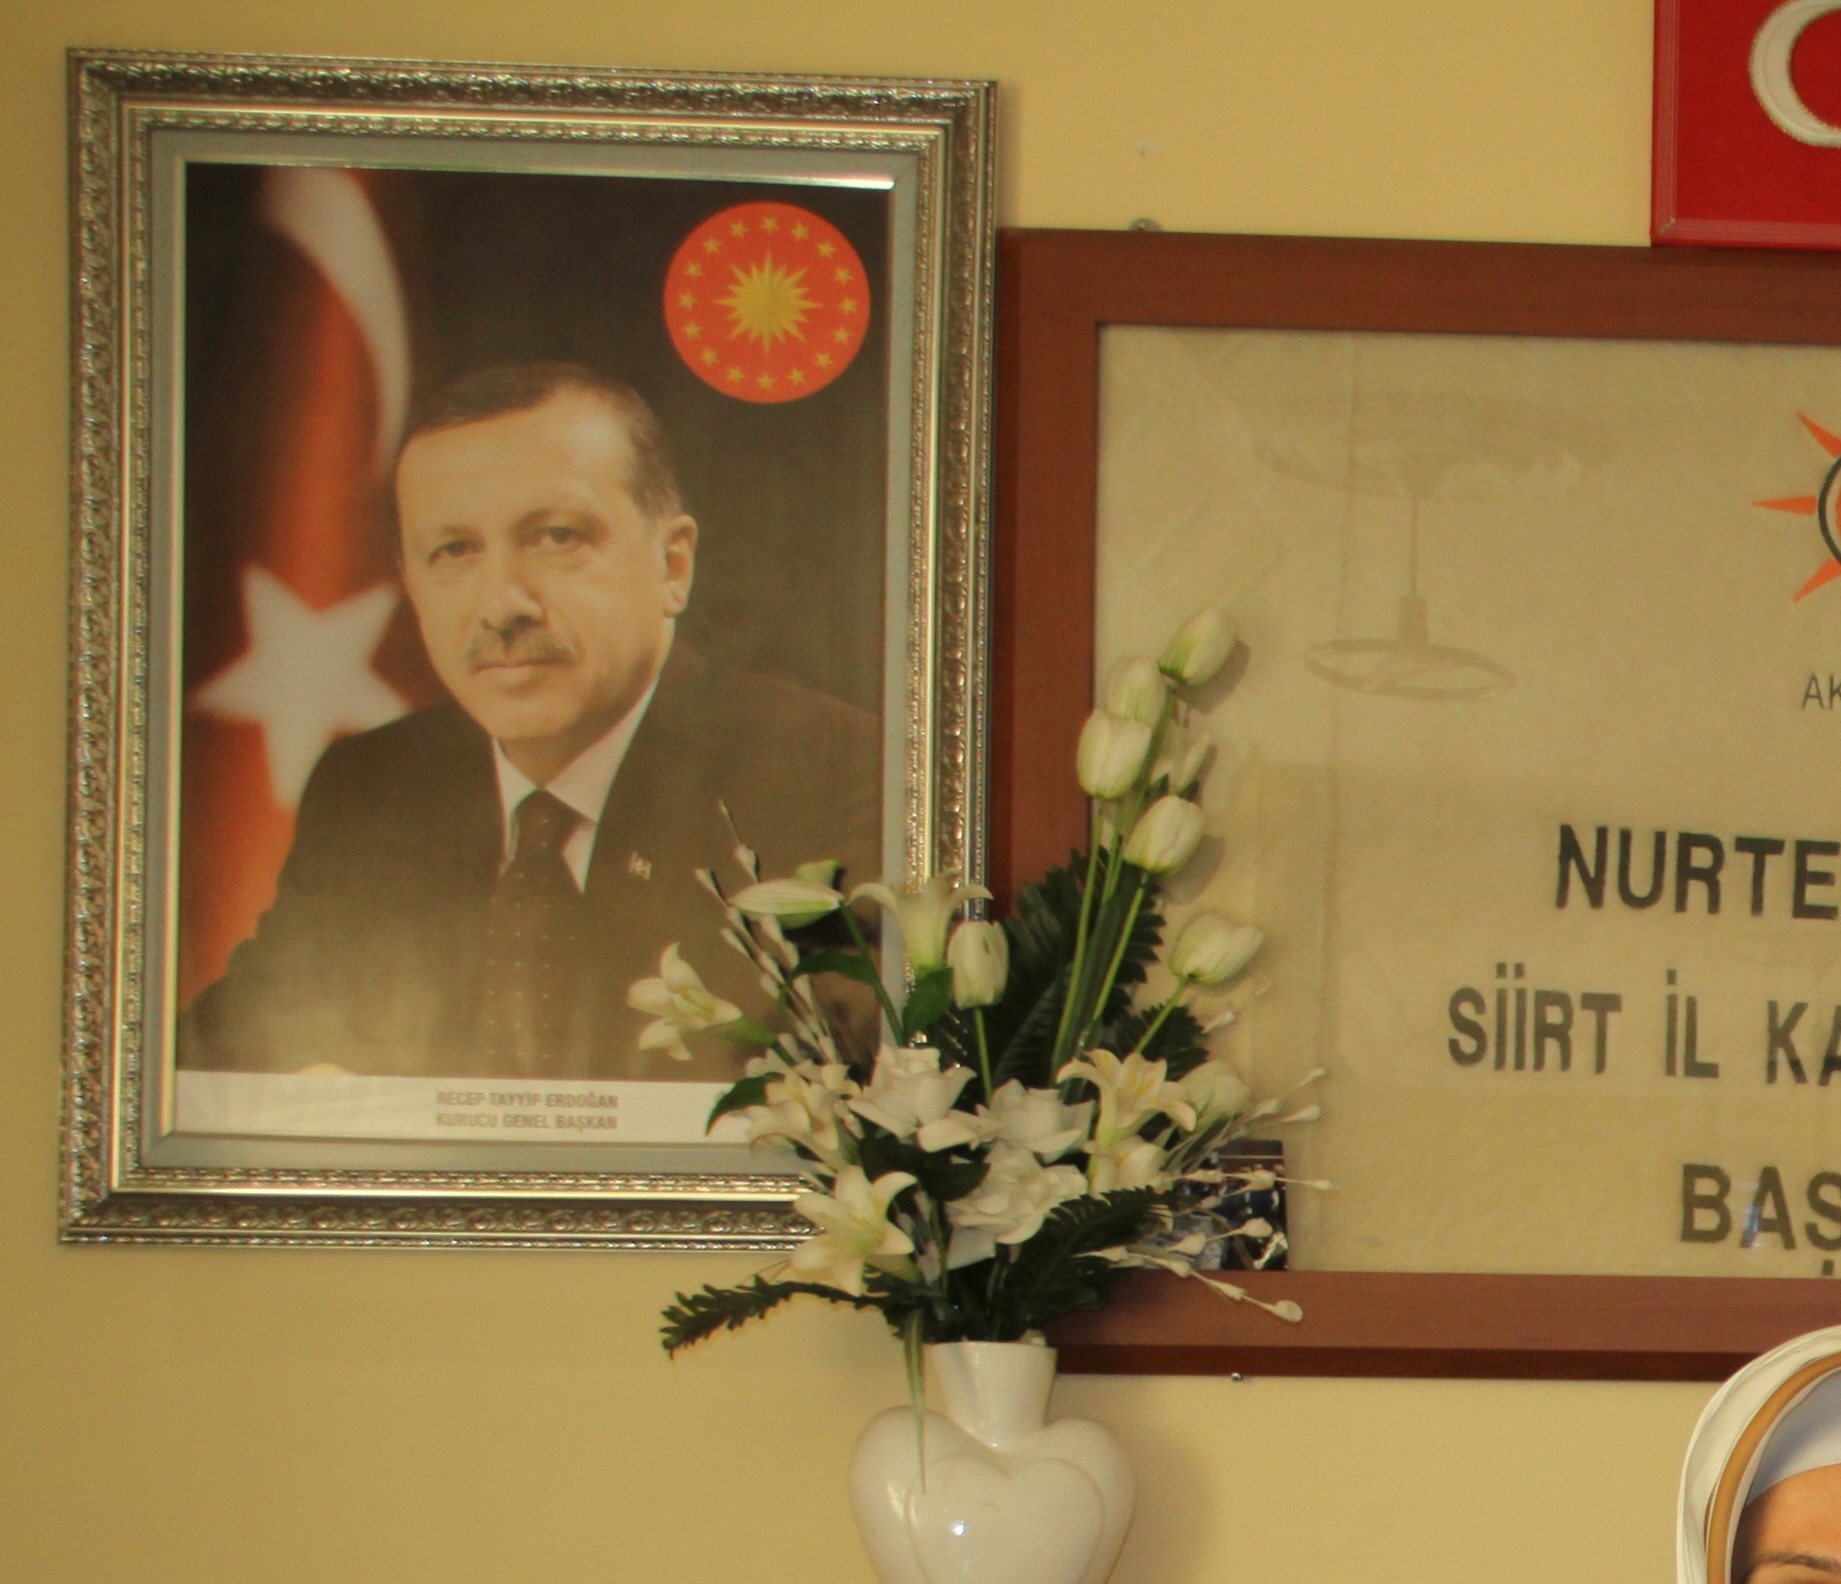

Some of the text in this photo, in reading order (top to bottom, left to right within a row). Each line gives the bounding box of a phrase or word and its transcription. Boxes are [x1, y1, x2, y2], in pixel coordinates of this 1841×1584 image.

[1447, 962, 1622, 1075] SİİRT
[1664, 969, 1720, 1079] İL
[436, 1091, 619, 1108] RECEP TAYYİP ERDOĞAN
[436, 1112, 619, 1132] KURUCU GENEL BAŞKAN
